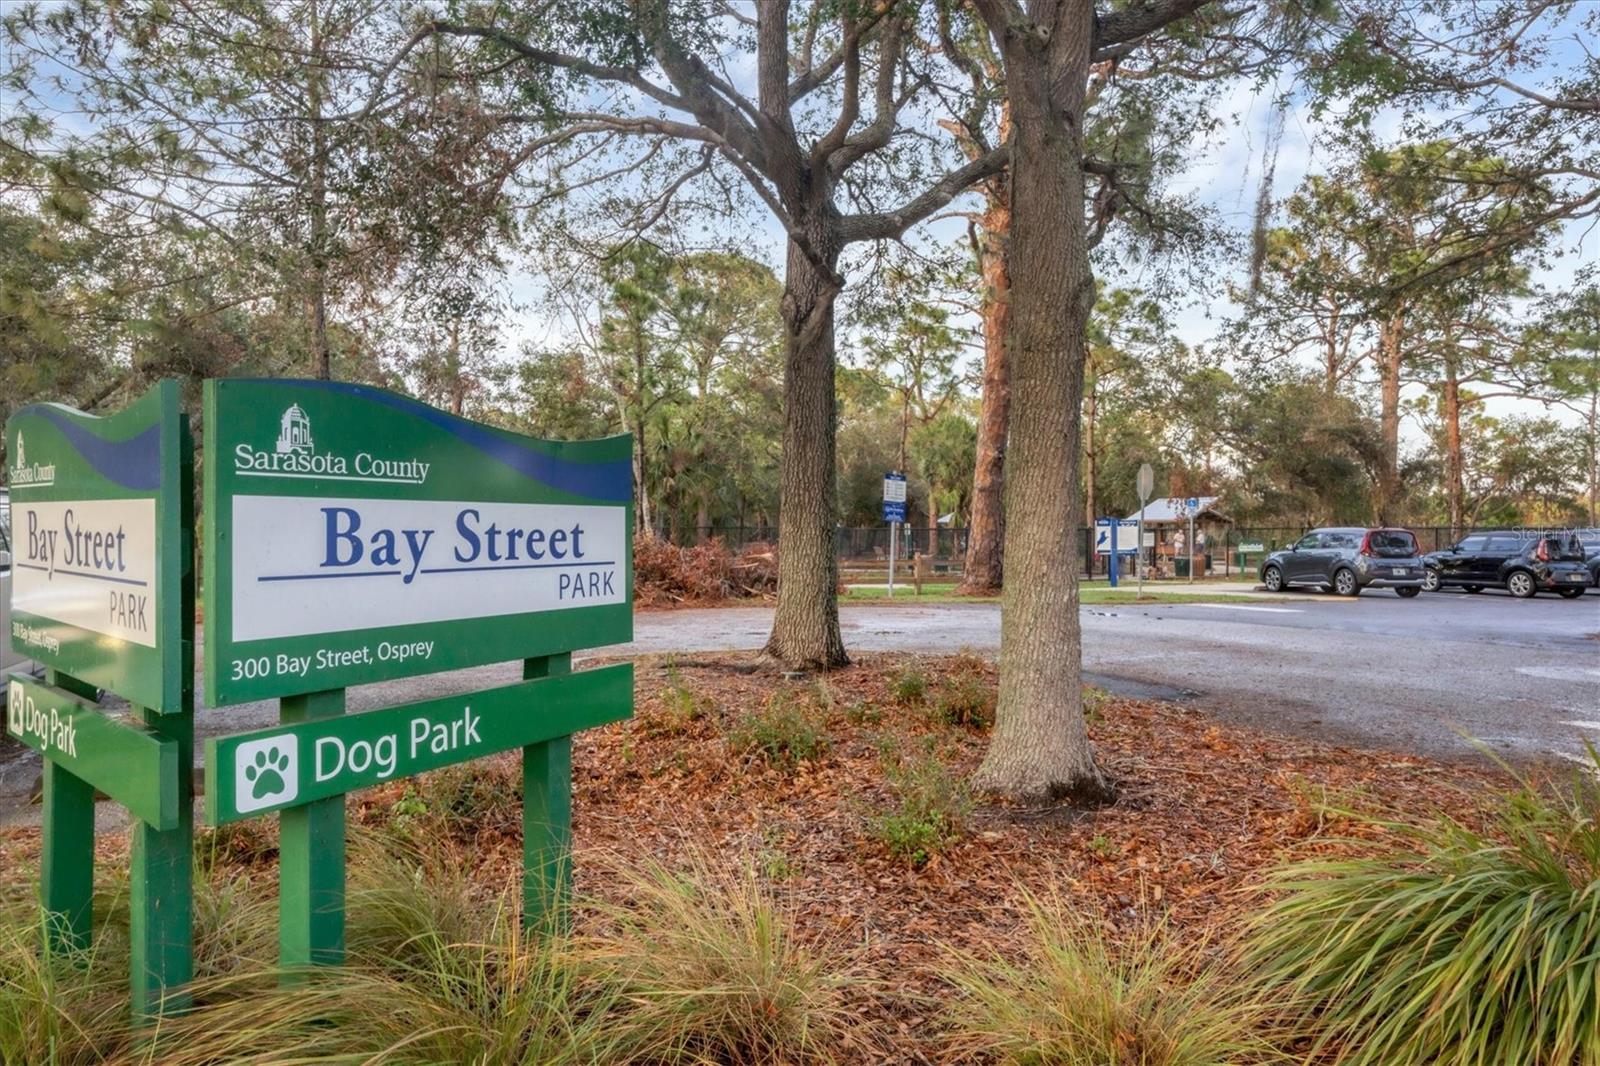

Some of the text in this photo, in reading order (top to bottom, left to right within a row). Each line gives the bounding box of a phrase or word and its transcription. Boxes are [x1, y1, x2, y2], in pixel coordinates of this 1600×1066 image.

[234, 443, 430, 484] Sarasota County
[27, 509, 126, 580] Bay Street
[320, 507, 585, 584] Bay Street
[559, 571, 615, 600] PARK
[110, 591, 148, 632] PARK
[231, 641, 434, 681] 300 Bay Street, Osprey
[26, 696, 77, 758] Dog Park
[315, 706, 482, 782] Dog Park
